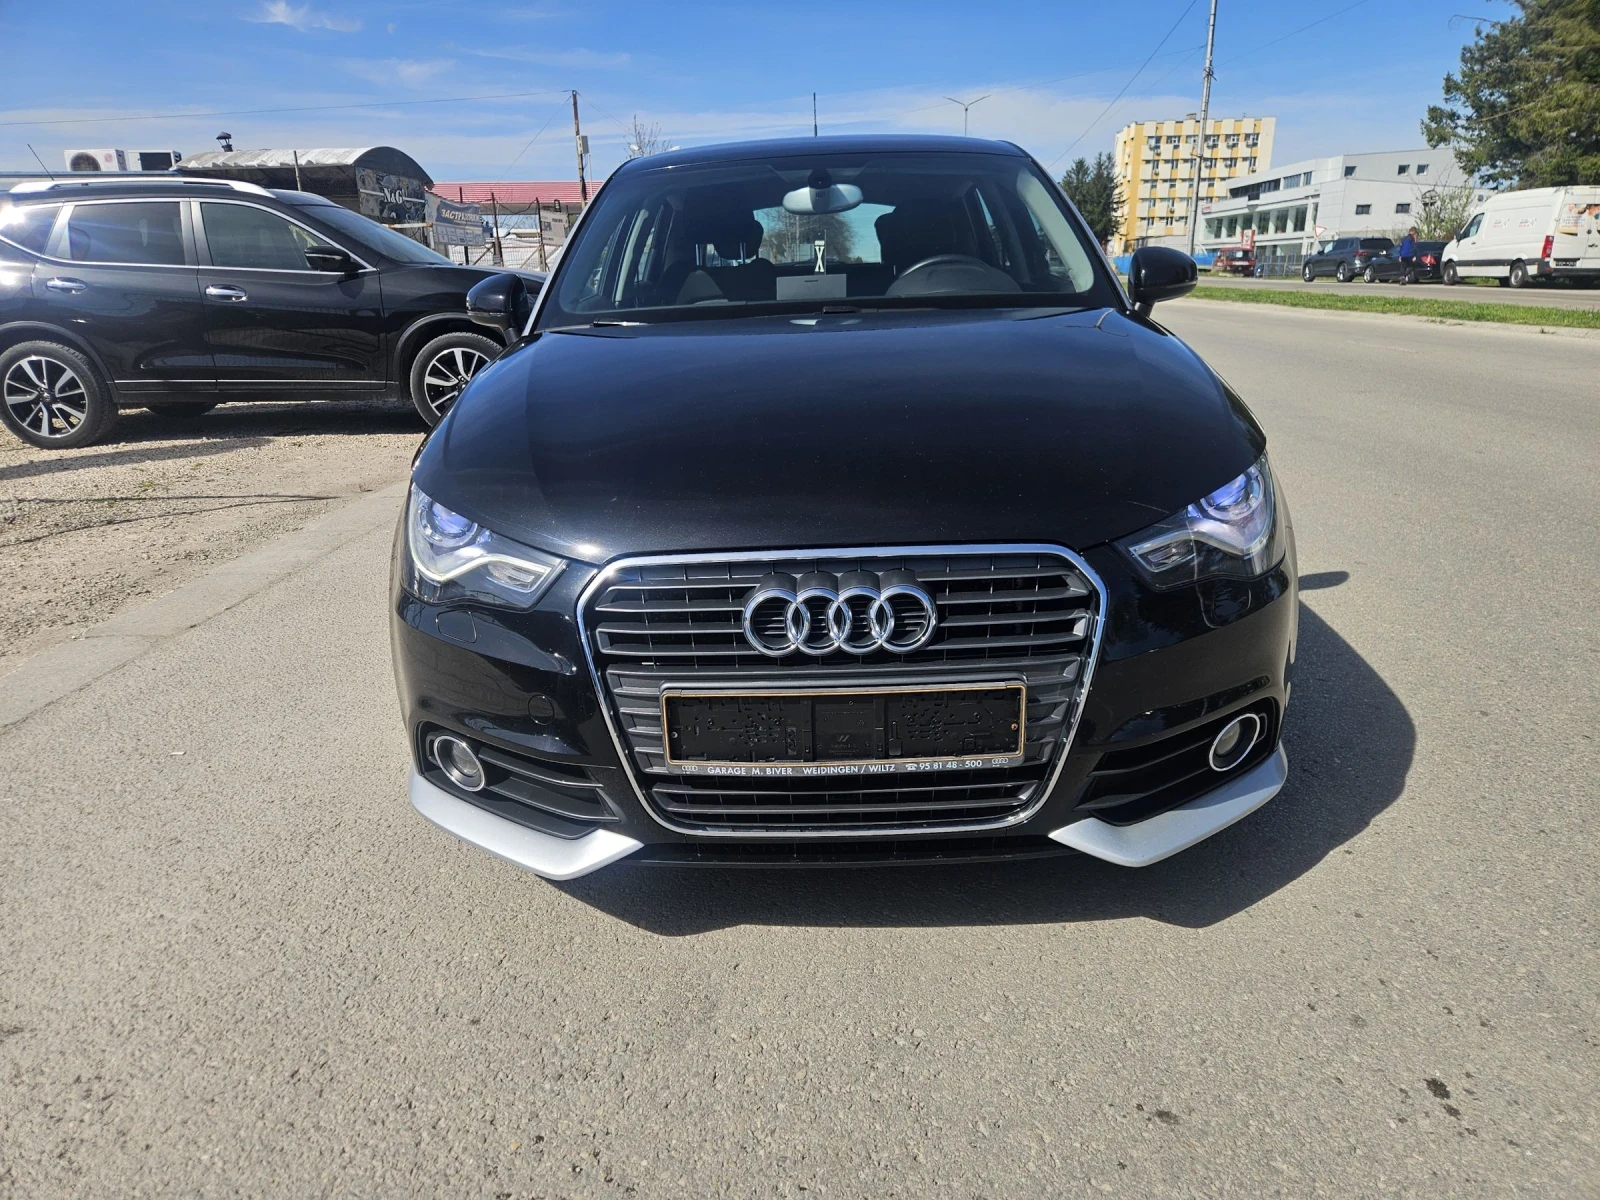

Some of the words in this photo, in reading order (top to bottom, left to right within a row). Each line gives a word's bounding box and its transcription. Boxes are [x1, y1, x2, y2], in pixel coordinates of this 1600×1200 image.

[707, 766, 747, 775] GARAGE
[751, 767, 764, 775] M.
[766, 767, 793, 775] BIVER
[802, 765, 858, 775] WEIDINGEN
[868, 763, 896, 773] WILTZ
[919, 762, 931, 771] 95
[933, 761, 943, 770] 81
[946, 760, 958, 770] 48
[965, 759, 983, 769] 500
